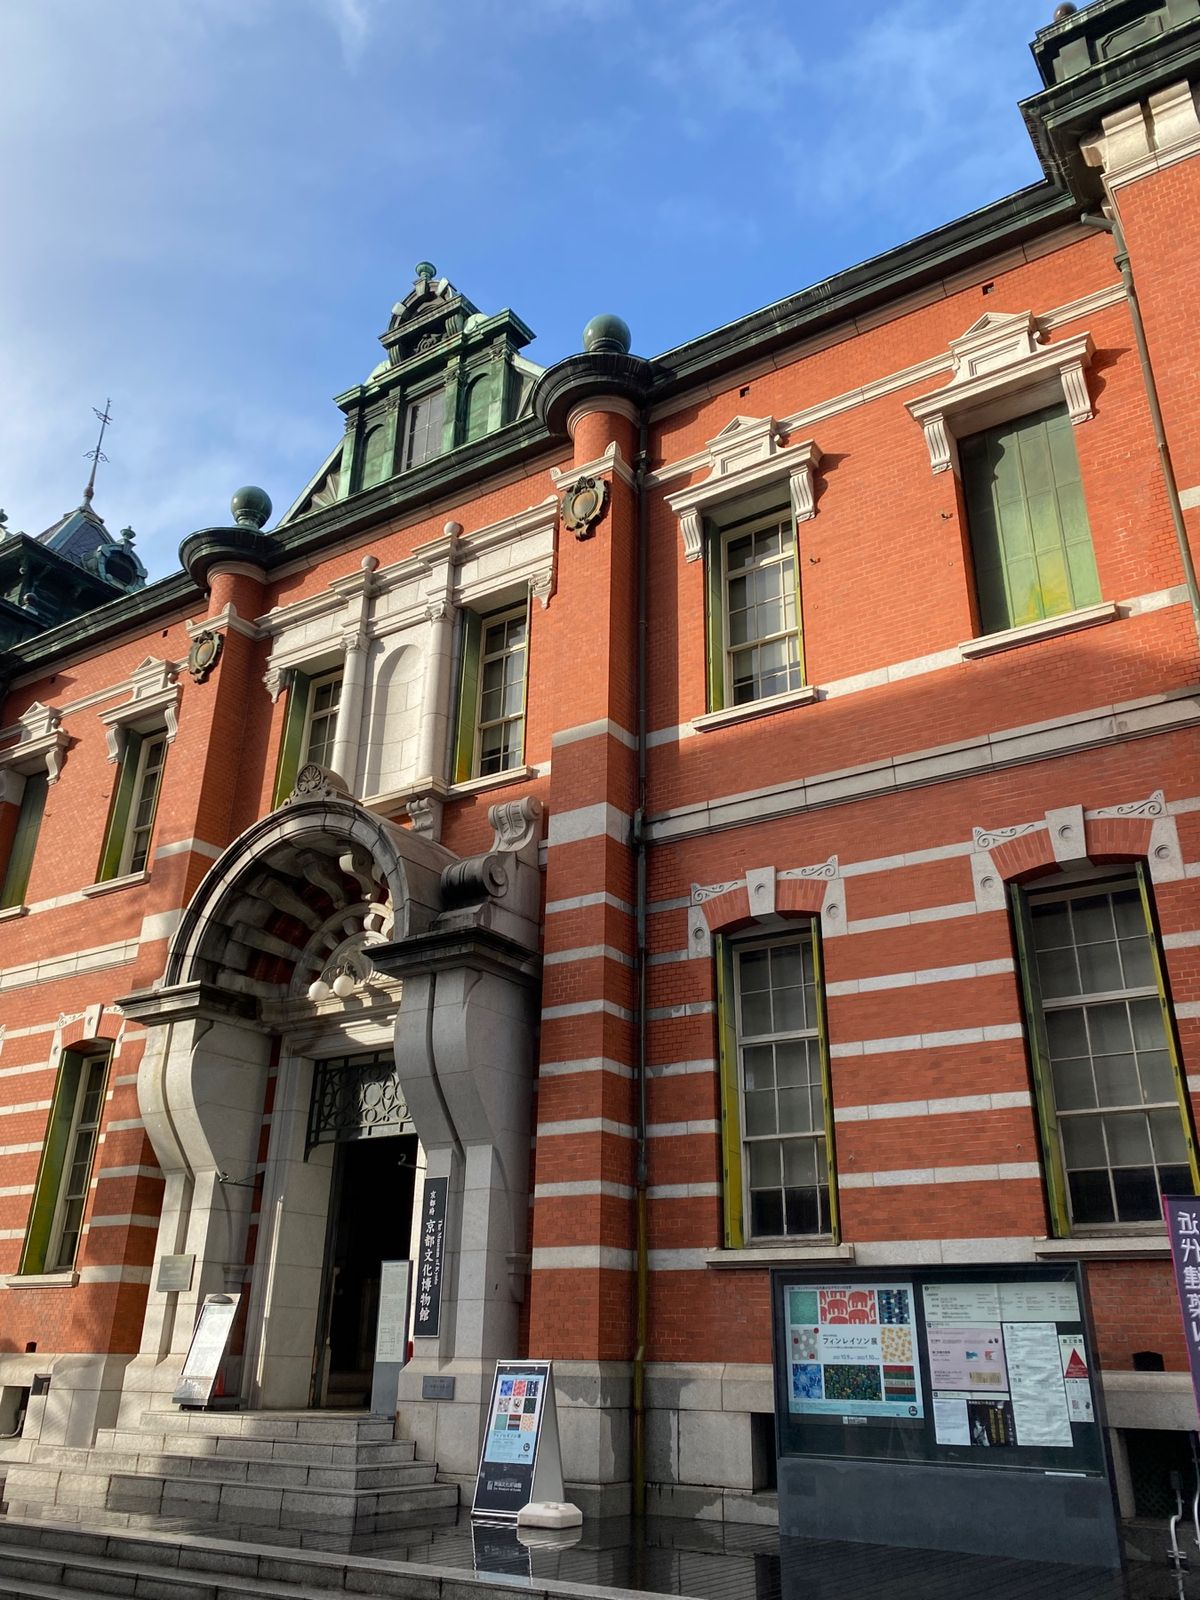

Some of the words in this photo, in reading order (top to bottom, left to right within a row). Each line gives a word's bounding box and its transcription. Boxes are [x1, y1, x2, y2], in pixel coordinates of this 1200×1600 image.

[428, 1190, 437, 1216] 京都府
[418, 1219, 436, 1322] 京都文化博物館
[822, 1337, 878, 1345] フィンレイソン展
